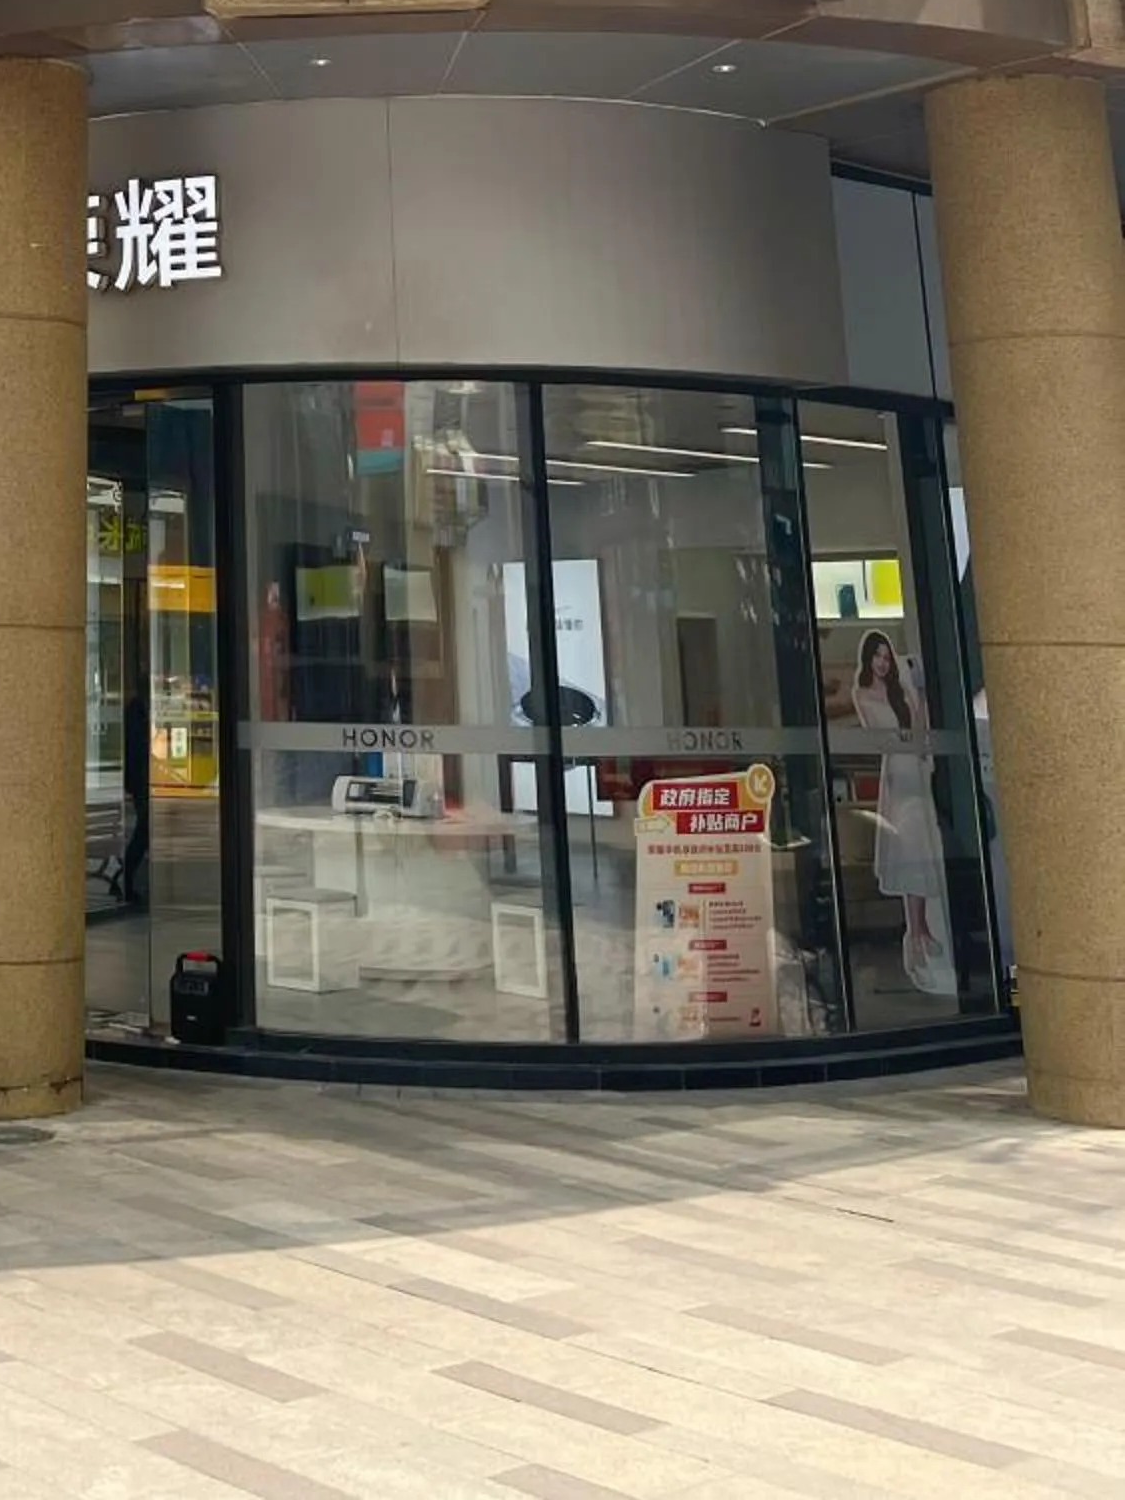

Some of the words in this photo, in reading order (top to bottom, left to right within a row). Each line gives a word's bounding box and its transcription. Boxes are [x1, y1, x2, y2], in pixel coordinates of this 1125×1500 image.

[342, 728, 434, 749] HONOR
[667, 731, 744, 751] HONOR
[660, 788, 731, 807] 政府指定
[690, 813, 758, 833] 补贴商户
